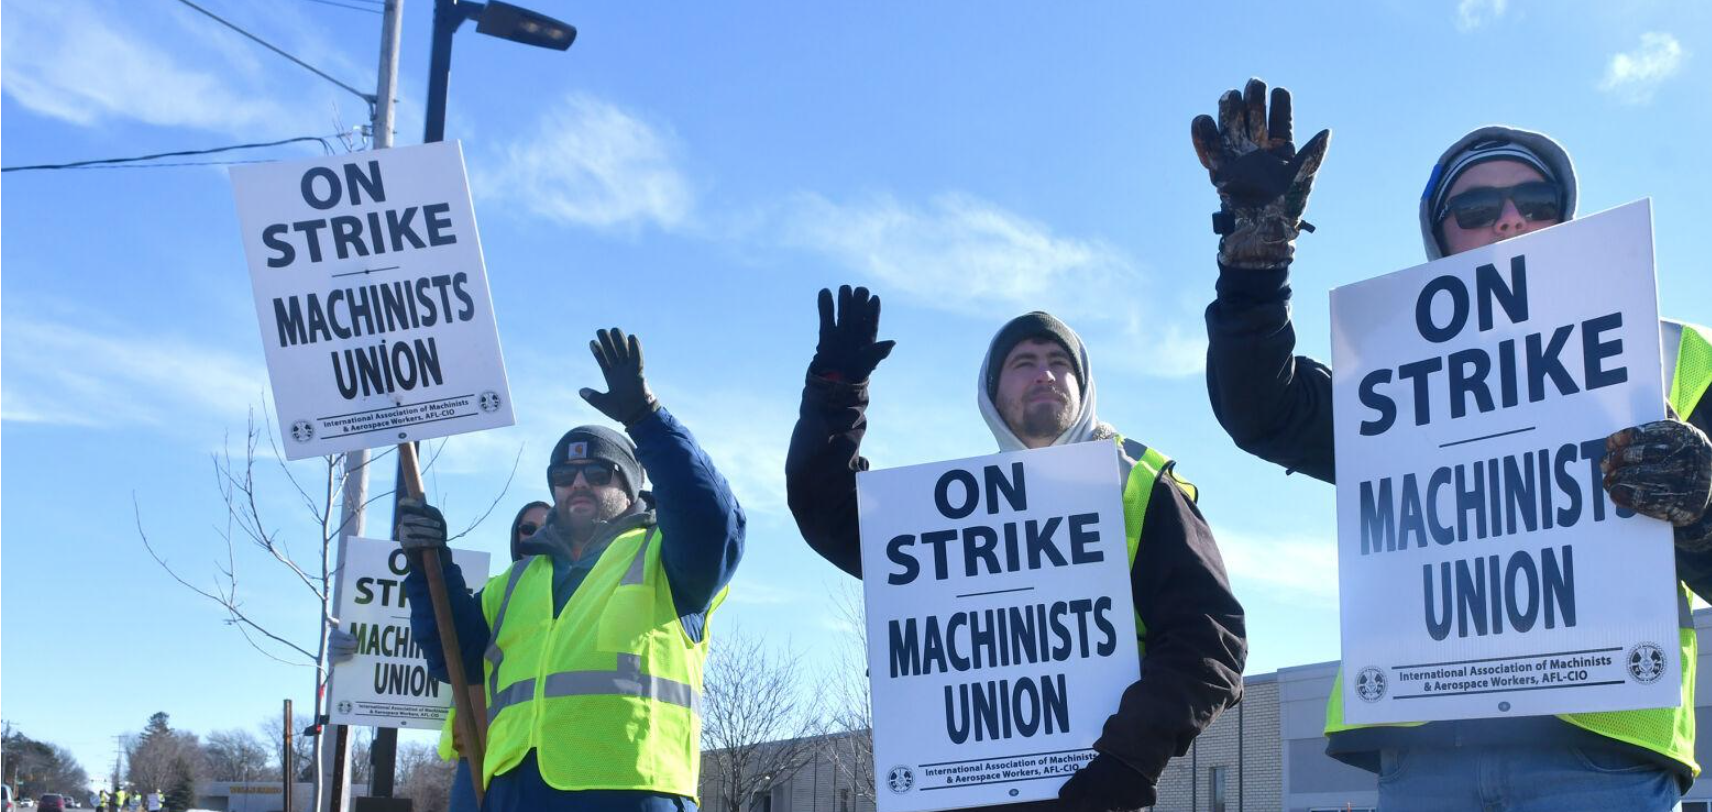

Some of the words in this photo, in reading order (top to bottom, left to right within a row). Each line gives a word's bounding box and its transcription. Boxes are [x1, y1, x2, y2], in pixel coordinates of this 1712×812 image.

[301, 161, 386, 210] ON
[262, 203, 457, 268] STRIKE
[273, 272, 475, 347] MACHINISTS
[1415, 255, 1529, 343] ON
[331, 337, 443, 400] UNION
[1358, 312, 1628, 436] STRIKE
[323, 414, 374, 428] International
[375, 406, 419, 420] Association
[420, 405, 428, 413] of
[429, 400, 469, 412] Machinists
[351, 418, 390, 432] Aerospace
[934, 462, 1028, 519] ON
[1360, 437, 1637, 555] MACHINIST
[388, 549, 411, 575] O
[886, 513, 1104, 585] STRIKE
[1423, 545, 1576, 641] UNION
[889, 596, 1117, 678] MACHINISTS
[1399, 667, 1468, 682] International
[1469, 663, 1533, 676] Association
[1535, 660, 1549, 671] of
[1550, 655, 1612, 669] Machinists
[945, 674, 1070, 745] UNION
[1424, 682, 1432, 691] &
[1433, 677, 1489, 692] Aerospace
[1491, 674, 1539, 687] Workers,
[1541, 670, 1588, 684] AFL-CIO
[925, 763, 983, 777] International
[985, 759, 1035, 771] Association
[1037, 757, 1048, 766] of
[946, 776, 953, 784] &
[955, 772, 1001, 784] Aerospace
[1002, 768, 1042, 778] Workers,
[1043, 763, 1079, 774] AFL-CIO
